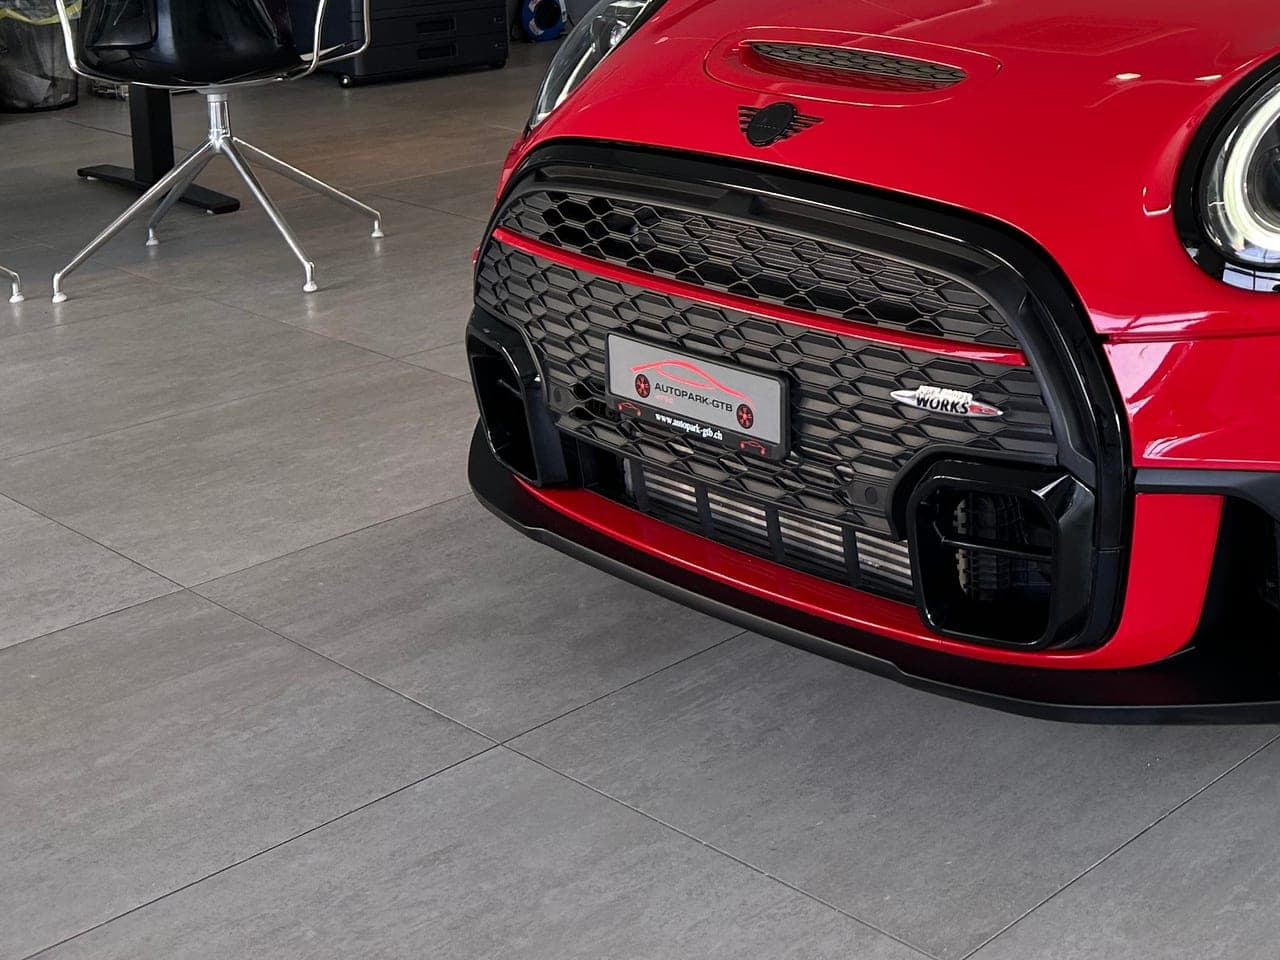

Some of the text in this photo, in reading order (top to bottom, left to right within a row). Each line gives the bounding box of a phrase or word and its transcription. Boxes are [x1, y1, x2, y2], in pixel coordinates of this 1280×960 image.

[654, 382, 733, 412] AUTOPARK-GTB
[916, 396, 969, 414] WORKS
[655, 413, 723, 440] www.autopark-gtb.ch
